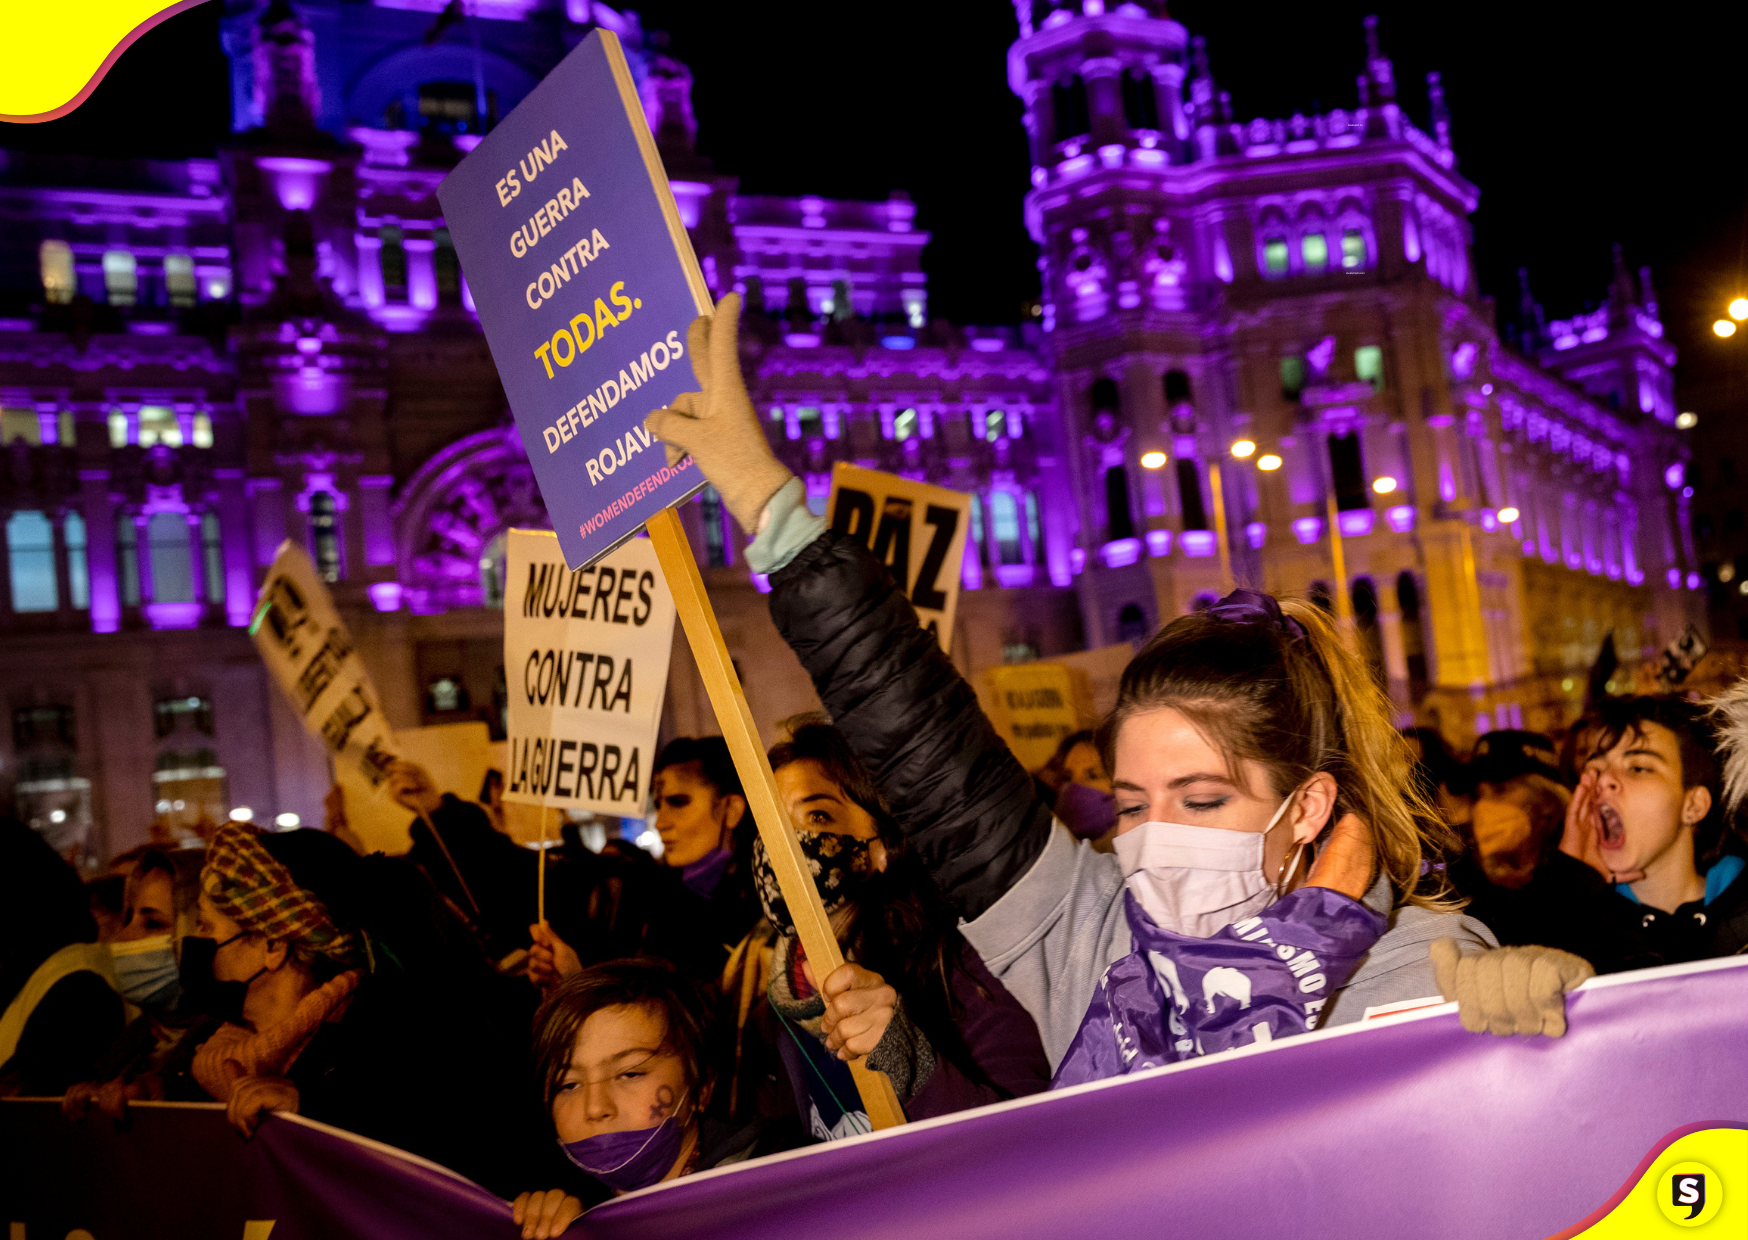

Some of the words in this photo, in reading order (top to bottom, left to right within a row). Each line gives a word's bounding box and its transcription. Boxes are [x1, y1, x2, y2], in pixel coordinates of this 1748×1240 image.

[495, 169, 521, 208] ES
[519, 129, 569, 182] UNA
[509, 176, 591, 258] GUERRA
[525, 227, 611, 309] CONTRA
[533, 280, 643, 380] TODAS.
[542, 330, 684, 454] DEFENDAMOS
[584, 404, 668, 487] ROJAV
[522, 562, 655, 627] MUJERES
[524, 649, 632, 714] CONTRA
